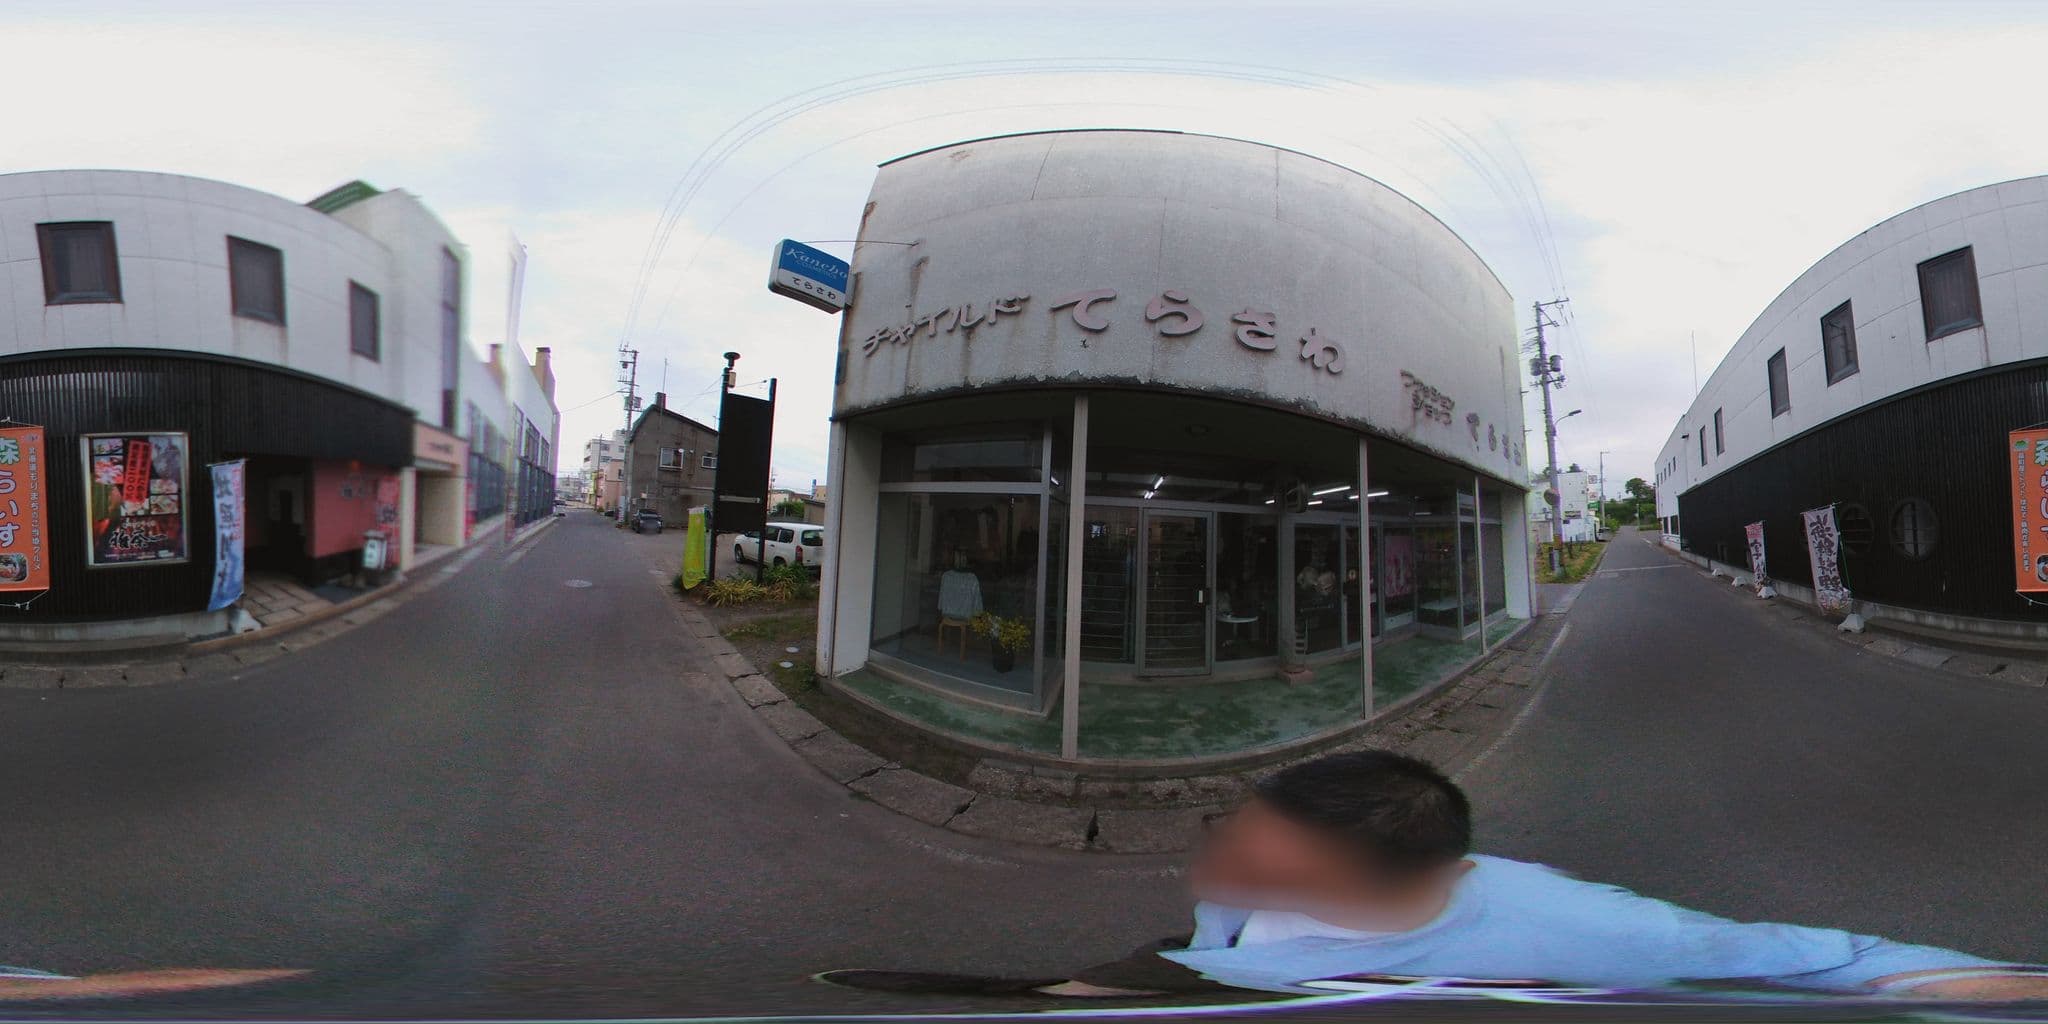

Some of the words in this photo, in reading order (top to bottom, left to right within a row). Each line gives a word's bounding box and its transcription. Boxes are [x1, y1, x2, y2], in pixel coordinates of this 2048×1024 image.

[792, 277, 836, 299] てらさわ
[863, 295, 1031, 358] チャイルド
[1050, 288, 1344, 374] てらさわ
